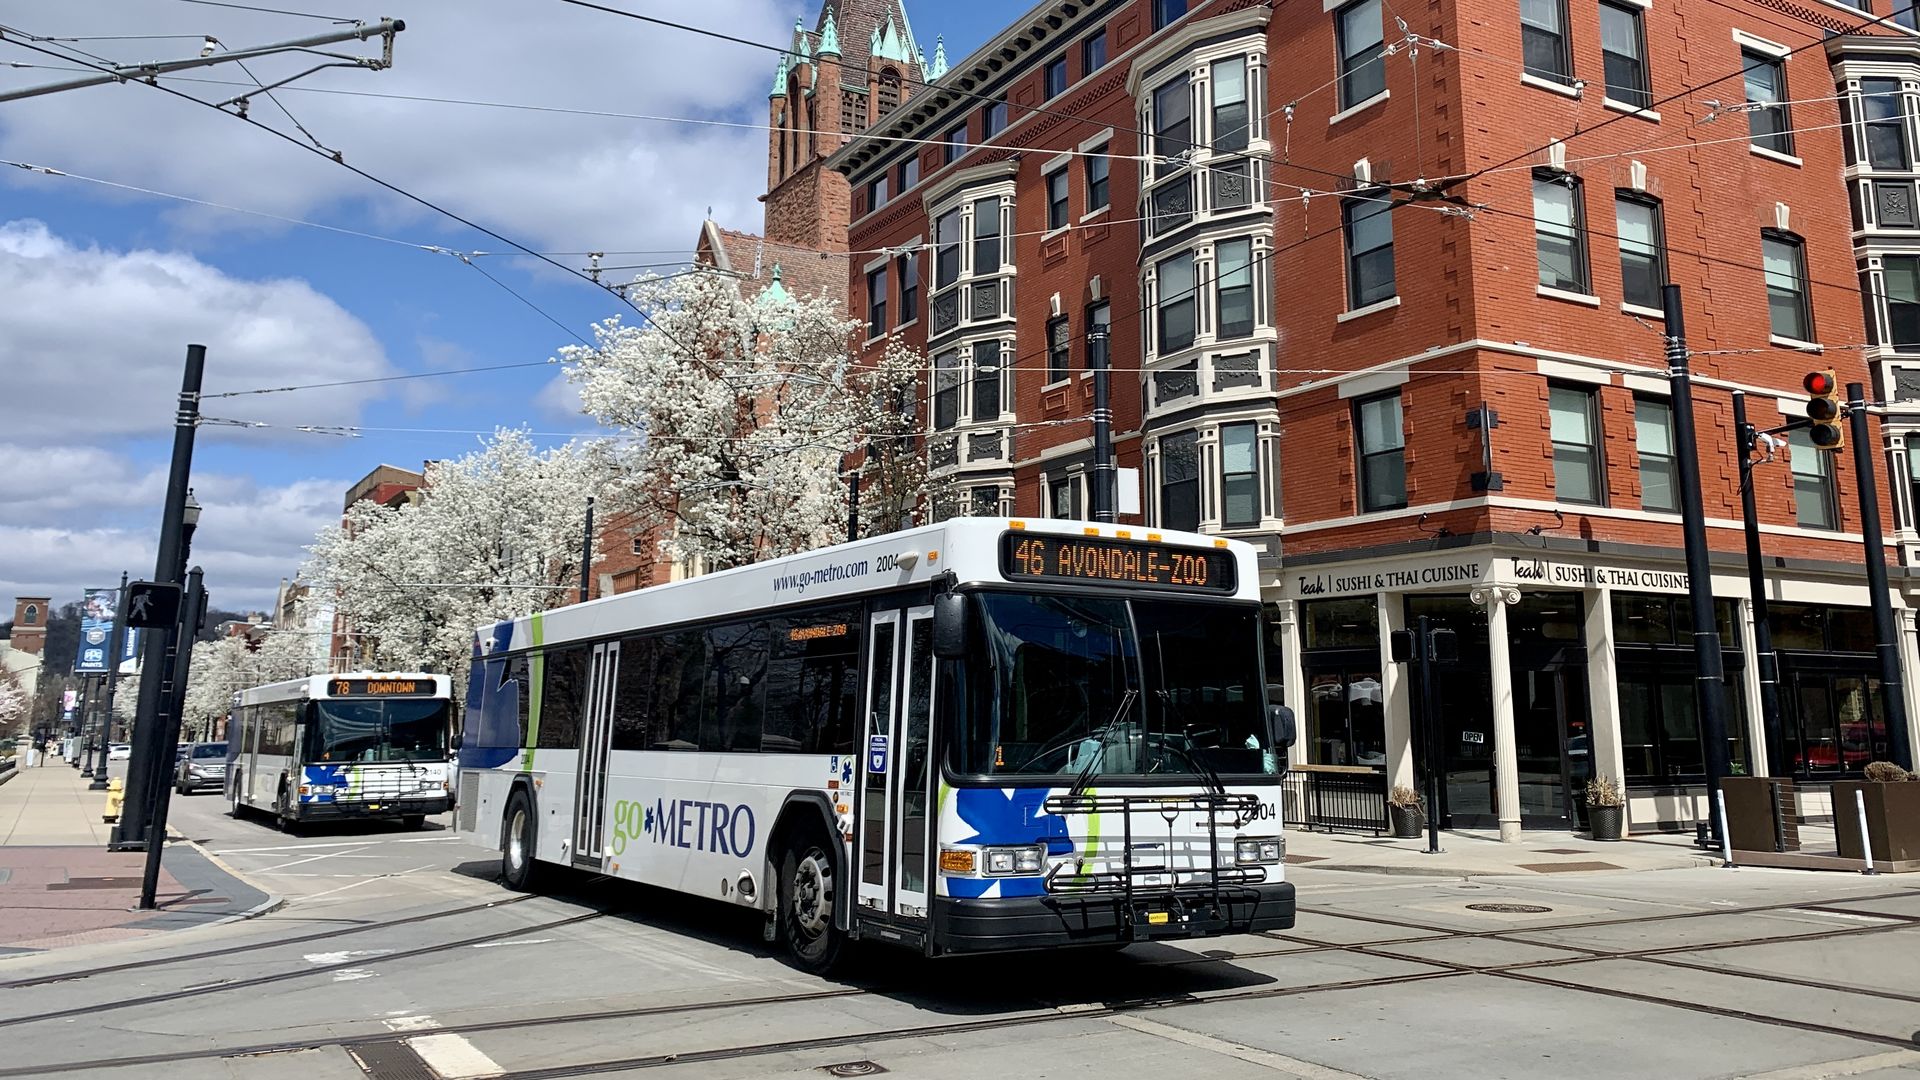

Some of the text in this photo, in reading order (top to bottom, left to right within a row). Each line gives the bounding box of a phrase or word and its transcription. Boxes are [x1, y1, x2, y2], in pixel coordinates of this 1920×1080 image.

[773, 560, 869, 594] www.go-metro.com
[876, 553, 899, 573] 2004
[1015, 539, 1207, 586] 46 AVONDALE-ZOO
[1298, 563, 1480, 595] Teak SUSHI & THAI CUISINE
[1511, 556, 1690, 590] Teak SUSHI & THAI CUISINE
[335, 681, 416, 695] 78 DOWNTOWN
[1464, 732, 1482, 742] OPEN
[612, 798, 755, 858] go METRO
